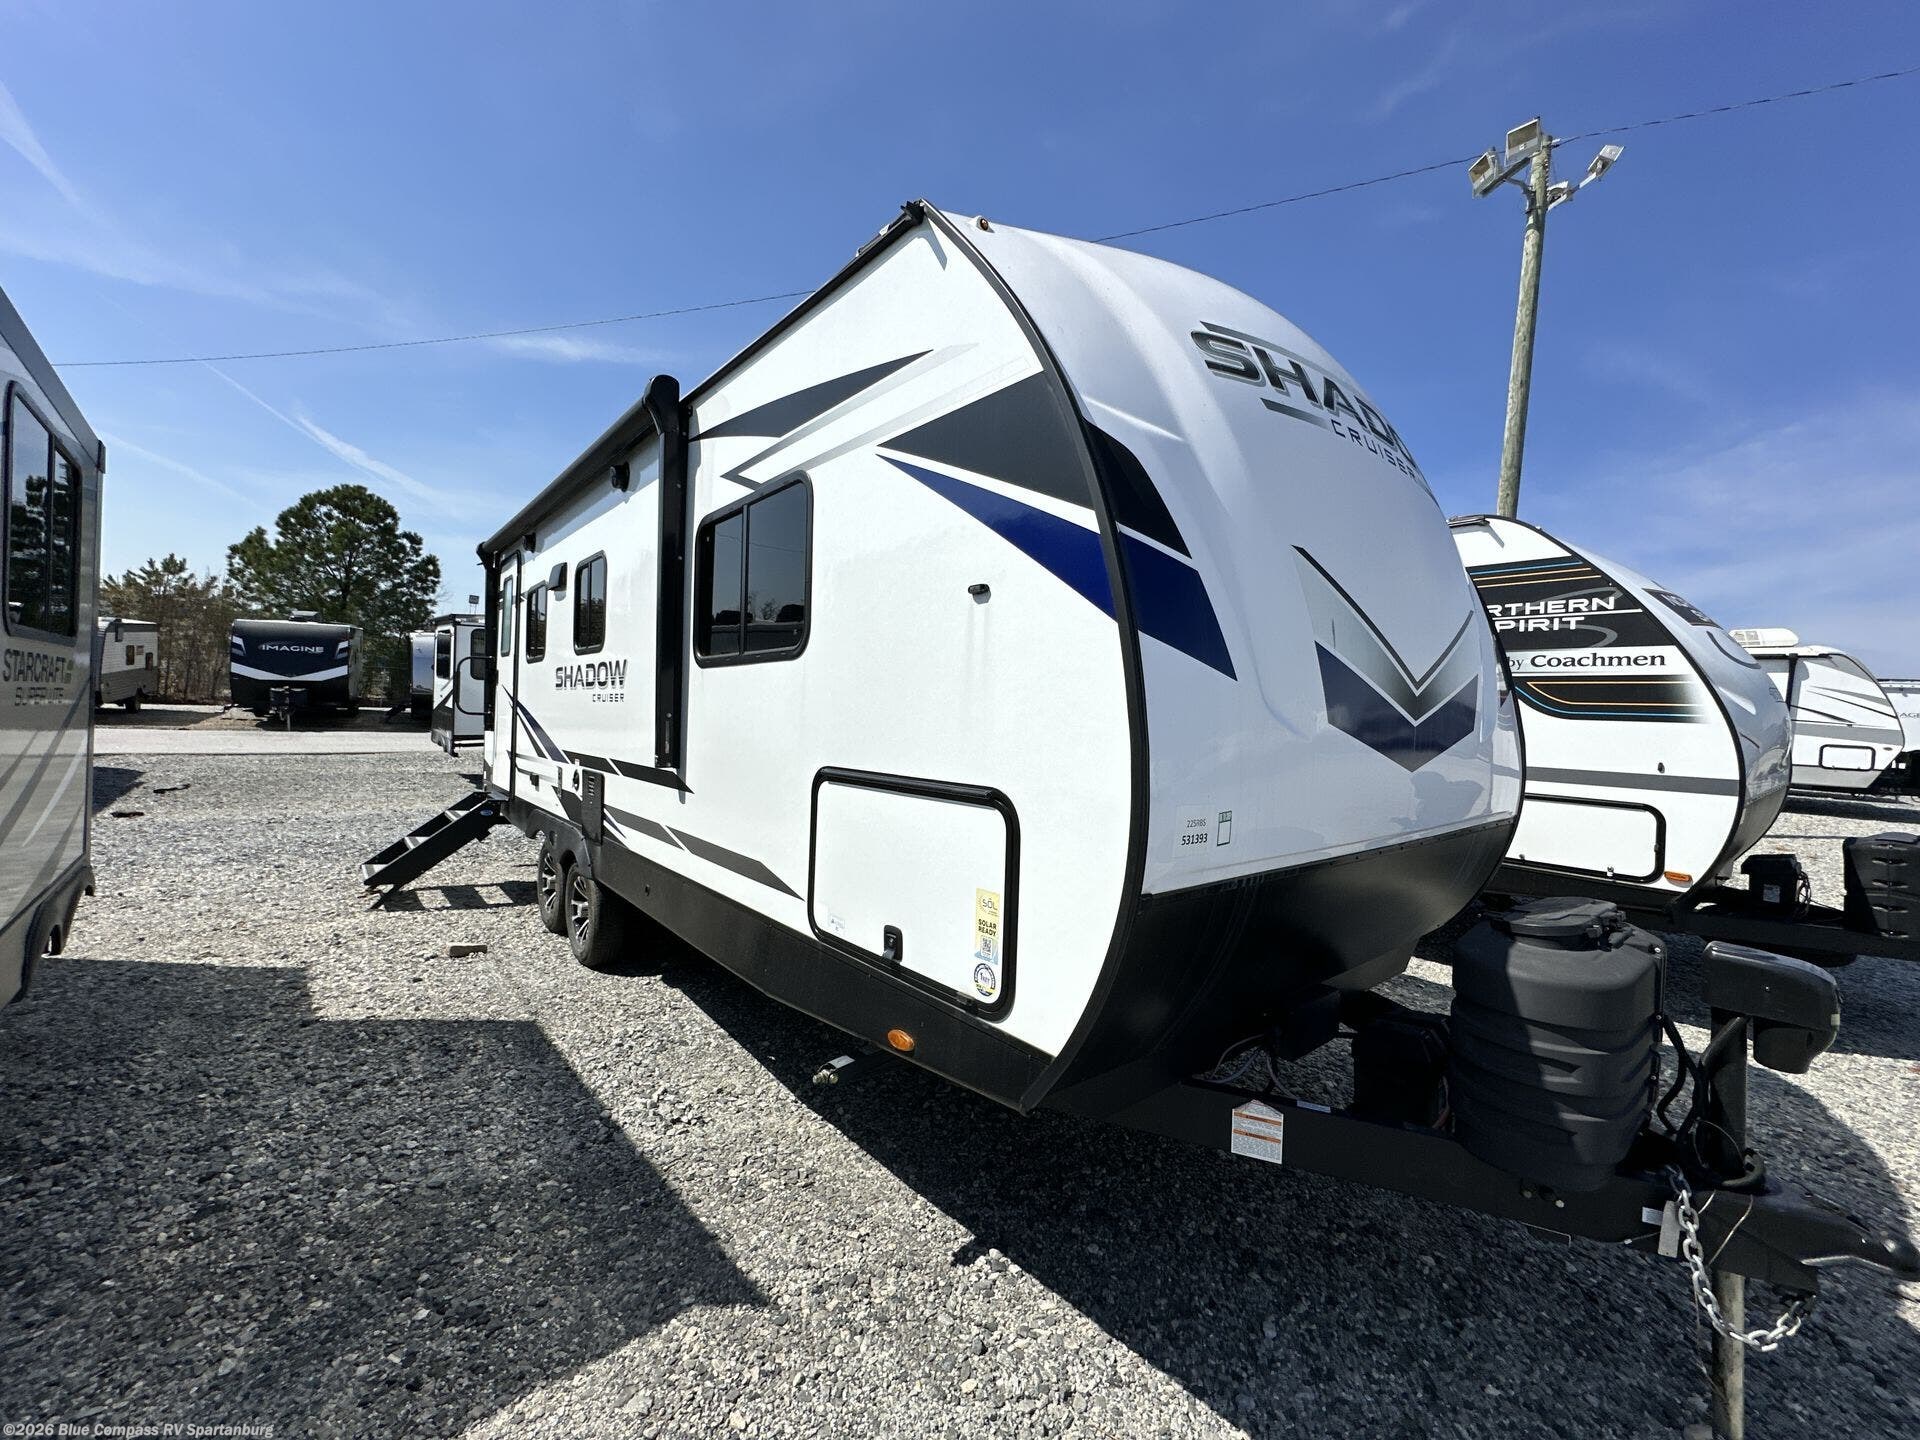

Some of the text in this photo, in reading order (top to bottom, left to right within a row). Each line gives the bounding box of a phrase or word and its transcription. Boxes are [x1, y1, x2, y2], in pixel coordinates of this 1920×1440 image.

[1331, 419, 1416, 480] CRUISER
[1487, 596, 1615, 617] RTHERN
[1494, 616, 1585, 633] PIRIT
[261, 643, 324, 653] IMAGINE
[3, 648, 66, 682] STARCRAFT
[1530, 652, 1666, 668] Coachmen
[555, 658, 627, 690] SHADOW
[592, 693, 625, 703] CRUISER
[1181, 832, 1208, 846] 531393
[978, 918, 997, 930] SOLAR
[978, 925, 997, 937] READY
